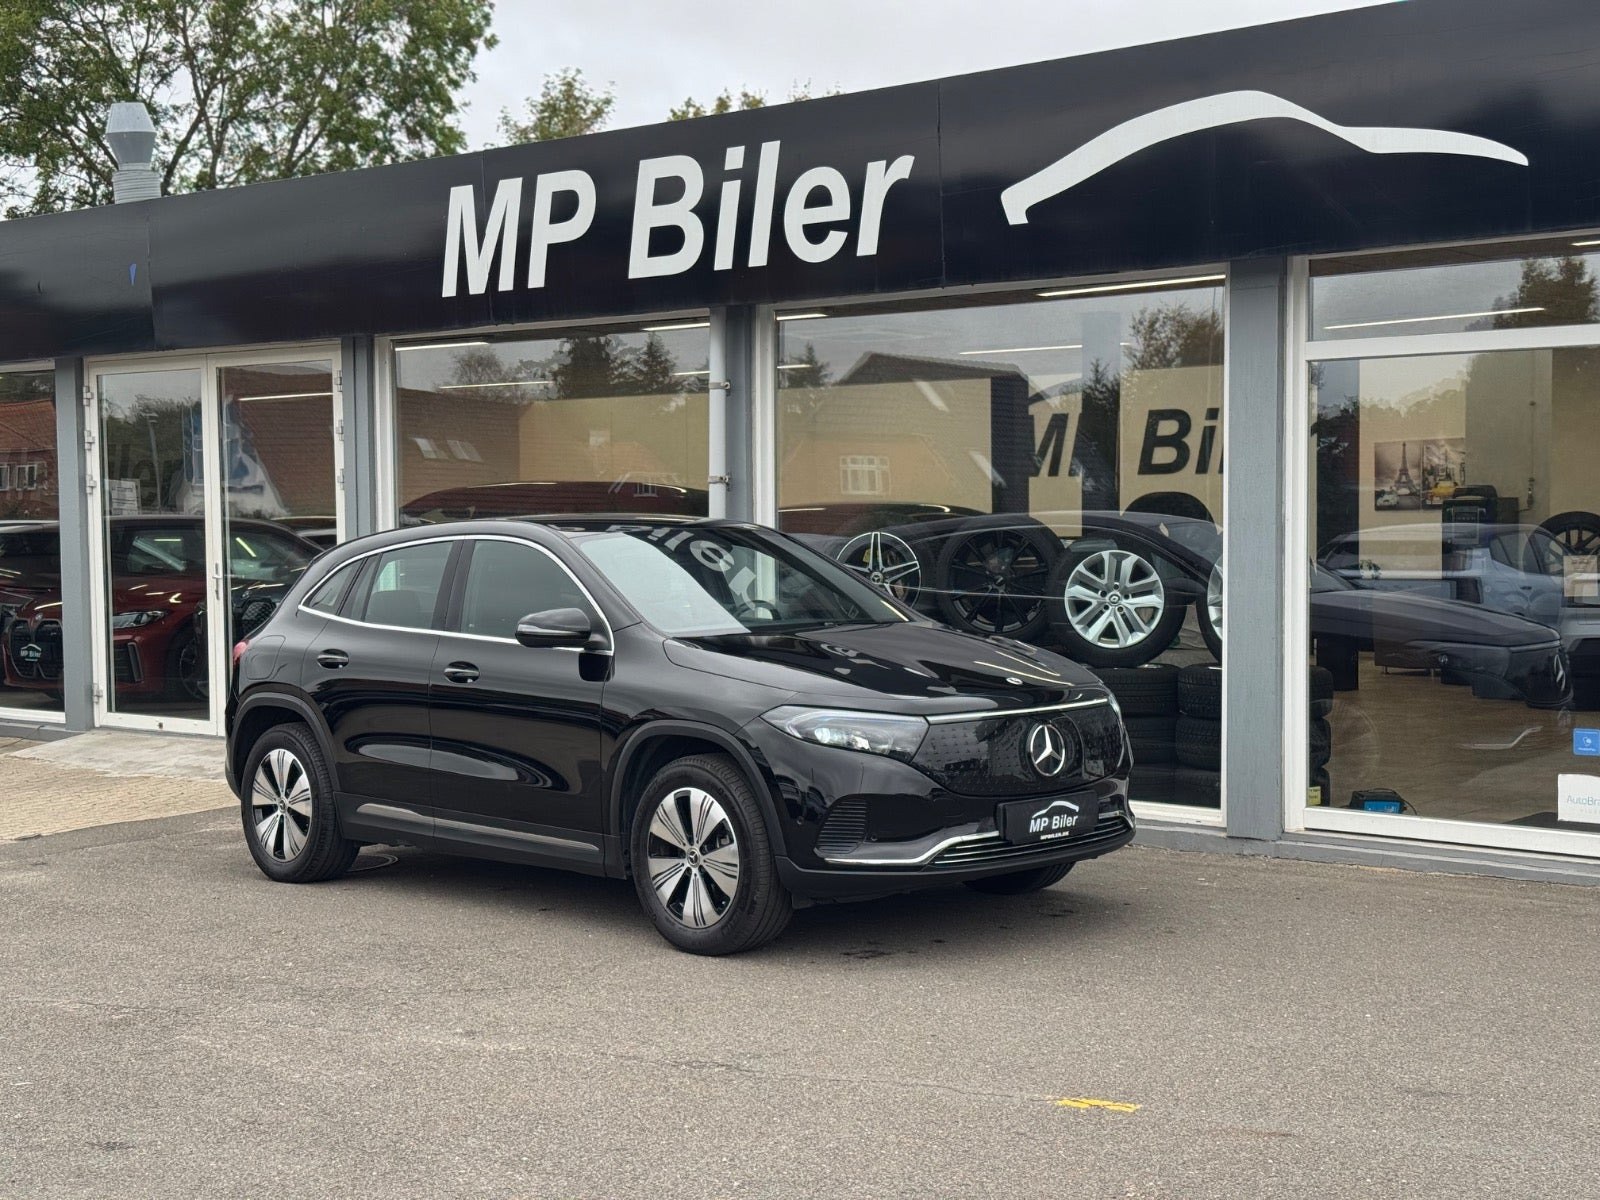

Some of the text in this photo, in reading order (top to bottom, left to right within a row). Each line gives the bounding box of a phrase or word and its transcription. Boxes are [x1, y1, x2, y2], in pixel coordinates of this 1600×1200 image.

[441, 140, 915, 298] MP Biler
[1138, 408, 1224, 475] Bi
[1029, 814, 1078, 833] MP Biler
